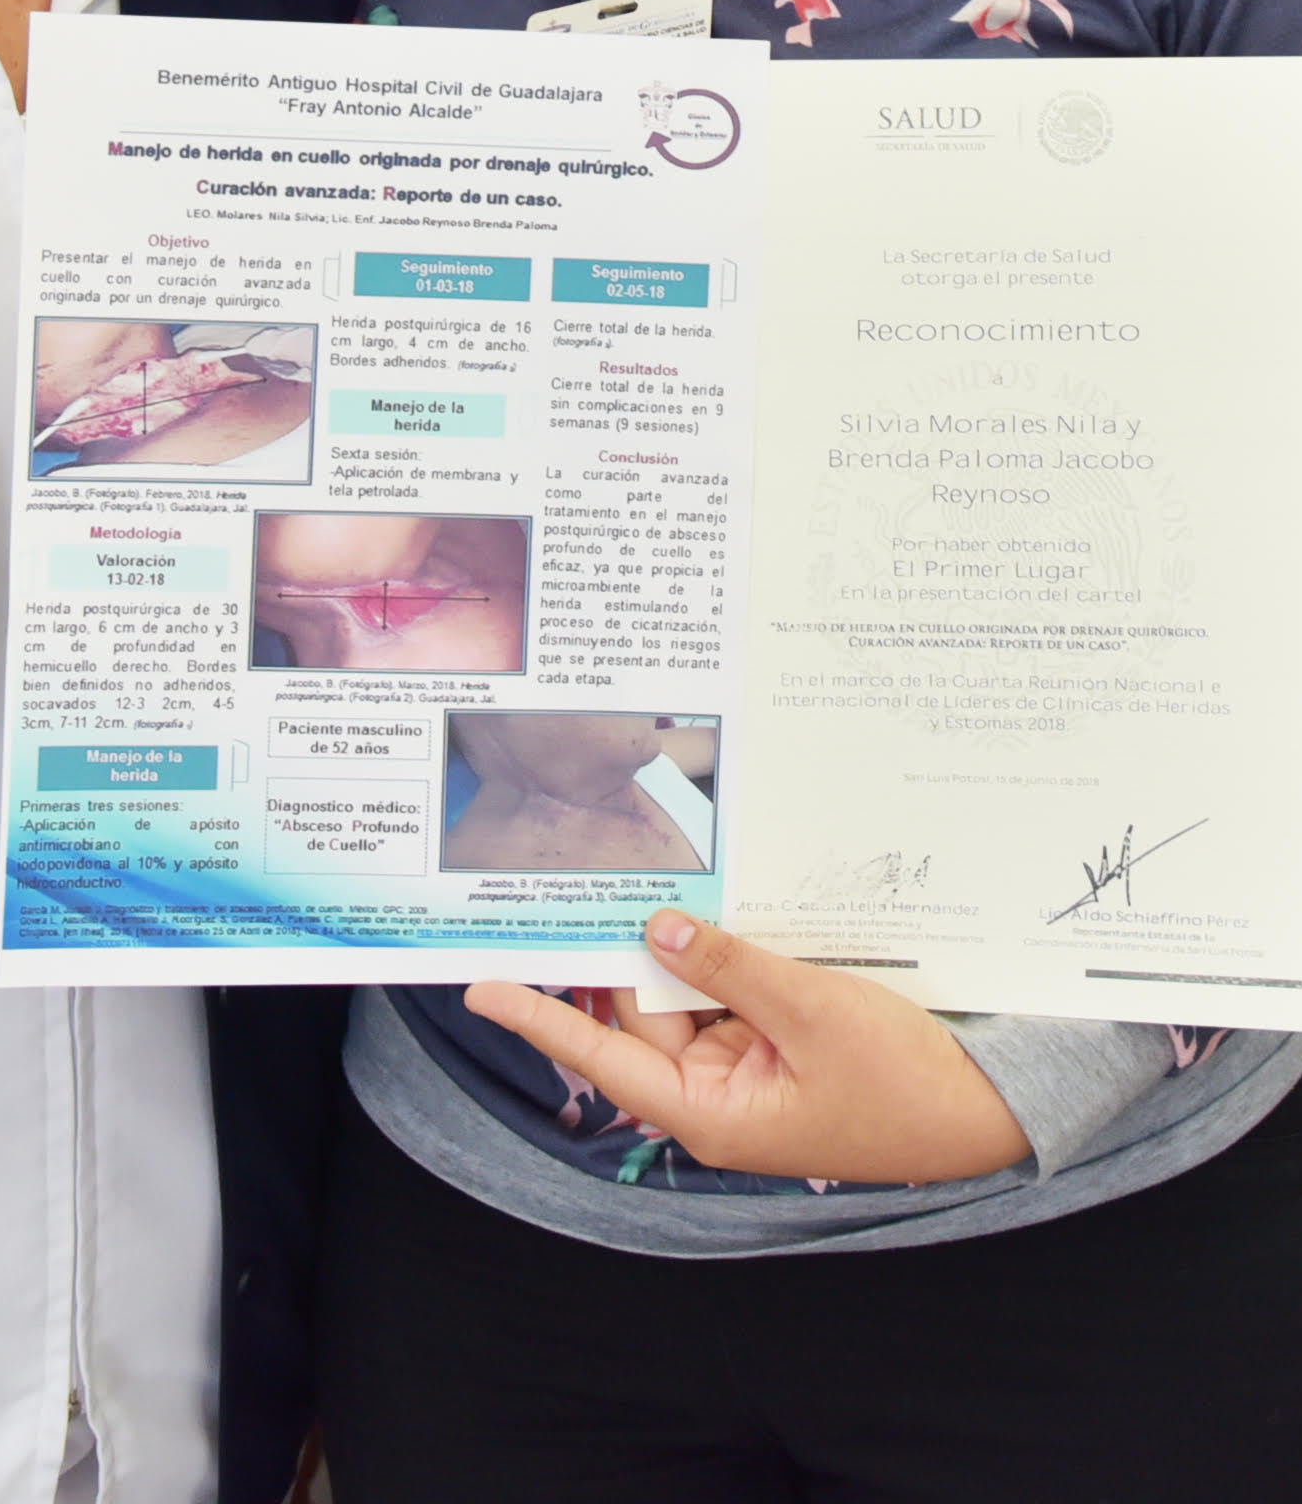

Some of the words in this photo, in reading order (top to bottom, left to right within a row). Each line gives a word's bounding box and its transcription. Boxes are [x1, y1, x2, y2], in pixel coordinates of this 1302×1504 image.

[157, 69, 260, 88] Benemérito
[267, 73, 338, 94] Antiguo
[345, 77, 418, 97] Hospital
[425, 80, 463, 97] Civil
[470, 82, 493, 98] de
[498, 83, 603, 105] Guadalajara
[278, 97, 327, 118] "Fray
[332, 99, 402, 117] Antonio
[408, 102, 482, 120] Alcalde"
[878, 106, 982, 130] SALUD
[107, 141, 173, 162] Manejo
[178, 143, 202, 160] de
[206, 144, 264, 162] herida
[270, 150, 293, 163] en
[297, 149, 351, 165] cuello
[358, 151, 442, 171] originada
[449, 157, 482, 173] por
[485, 155, 552, 176] drenaje
[557, 159, 654, 180] quirúrgico.
[196, 179, 278, 197] Curación
[284, 184, 376, 201] avanzada:
[382, 185, 453, 206] Reporte
[459, 188, 482, 205] de
[486, 193, 510, 206] un
[514, 194, 563, 208] caso.
[147, 233, 210, 252] Objetivo
[40, 248, 110, 265] Presentar
[121, 251, 133, 265] el
[146, 255, 198, 271] manejo
[209, 254, 226, 269] de
[238, 255, 282, 270] herida
[294, 260, 312, 271] en
[882, 249, 905, 264] La
[910, 248, 1017, 264] Secretaría
[1023, 249, 1047, 264] de
[1051, 249, 1111, 264] Salud
[401, 260, 494, 278] Seguimiento
[591, 265, 684, 283] Seguimiento
[40, 269, 81, 284] cuello
[106, 274, 133, 285] con
[157, 274, 217, 288] curación
[243, 276, 312, 291] avanzada
[415, 280, 474, 295] 01-03-18
[901, 272, 977, 290] otorga
[983, 271, 1000, 287] el
[1007, 272, 1094, 289] presente
[39, 288, 101, 306] originada
[108, 292, 131, 307] por
[135, 294, 153, 304] un
[158, 291, 207, 309] drenaje
[215, 293, 283, 311] quirúrgico.
[606, 284, 665, 300] 02-05-18
[331, 315, 377, 329] Herida
[384, 317, 482, 336] postquirúrgica
[489, 319, 507, 334] de
[515, 320, 532, 335] 16
[553, 318, 593, 334] Cierre
[599, 321, 629, 335] total
[633, 322, 650, 336] de
[654, 322, 667, 337] la
[671, 323, 715, 338] herida.
[856, 319, 1141, 345] Reconocimiento
[330, 336, 352, 347] cm
[361, 334, 398, 352] largo,
[408, 335, 417, 349] 4
[426, 339, 449, 350] cm
[457, 337, 475, 351] de
[484, 338, 529, 353] ancho.
[330, 353, 377, 368] Bordes
[383, 353, 450, 370] adheridos.
[599, 361, 678, 377] Resultados
[550, 376, 593, 392] Cierre
[599, 379, 630, 393] total
[636, 380, 655, 395] de
[662, 381, 674, 396] la
[681, 382, 725, 397] herida
[370, 398, 425, 417] Manejo
[427, 400, 447, 414] de
[451, 401, 465, 415] la
[550, 396, 570, 410] sin
[577, 399, 684, 415] complicaciones
[691, 405, 708, 416] en
[715, 403, 724, 417] 9
[394, 417, 441, 433] herida
[549, 417, 610, 430] semanas
[615, 417, 630, 433] (9
[634, 418, 700, 437] sesiones)
[839, 414, 920, 434] Silvia
[929, 414, 1047, 435] Morales
[1056, 414, 1117, 435] Nila
[1126, 418, 1141, 440] y
[598, 449, 679, 466] Conclusión
[828, 448, 929, 469] Brenda
[939, 449, 1043, 469] Paloma
[1052, 450, 1154, 471] Jacobo
[931, 484, 1051, 509] Reynoso
[892, 537, 926, 553] Por
[935, 537, 988, 553] haber
[997, 537, 1092, 553] obtenido
[96, 553, 176, 568] Valoración
[106, 572, 165, 586] 13-02-18
[893, 561, 914, 577] El
[925, 561, 1004, 578] Primer
[1015, 562, 1090, 584] Lugar
[841, 586, 864, 601] En
[873, 586, 891, 601] la
[898, 586, 1031, 604] presentación
[1038, 587, 1068, 602] del
[1076, 588, 1142, 603] cartel
[831, 623, 847, 633] DE
[900, 624, 915, 633] EN
[919, 624, 965, 634] CUELLO
[968, 624, 1038, 635] ORIGINADA
[1043, 625, 1066, 635] POR
[1070, 626, 1123, 636] DRENAJE
[990, 638, 1043, 649] REPORTE
[1047, 640, 1062, 649] DE
[1066, 640, 1084, 650] UN
[278, 721, 343, 736] Paciente
[347, 723, 423, 737] masculino
[310, 740, 329, 754] de
[332, 741, 349, 754] 52
[354, 742, 390, 755] años
[267, 799, 354, 815] Diagnostico
[362, 801, 421, 815] médico:
[352, 820, 419, 834] Profundo
[307, 838, 325, 851] de
